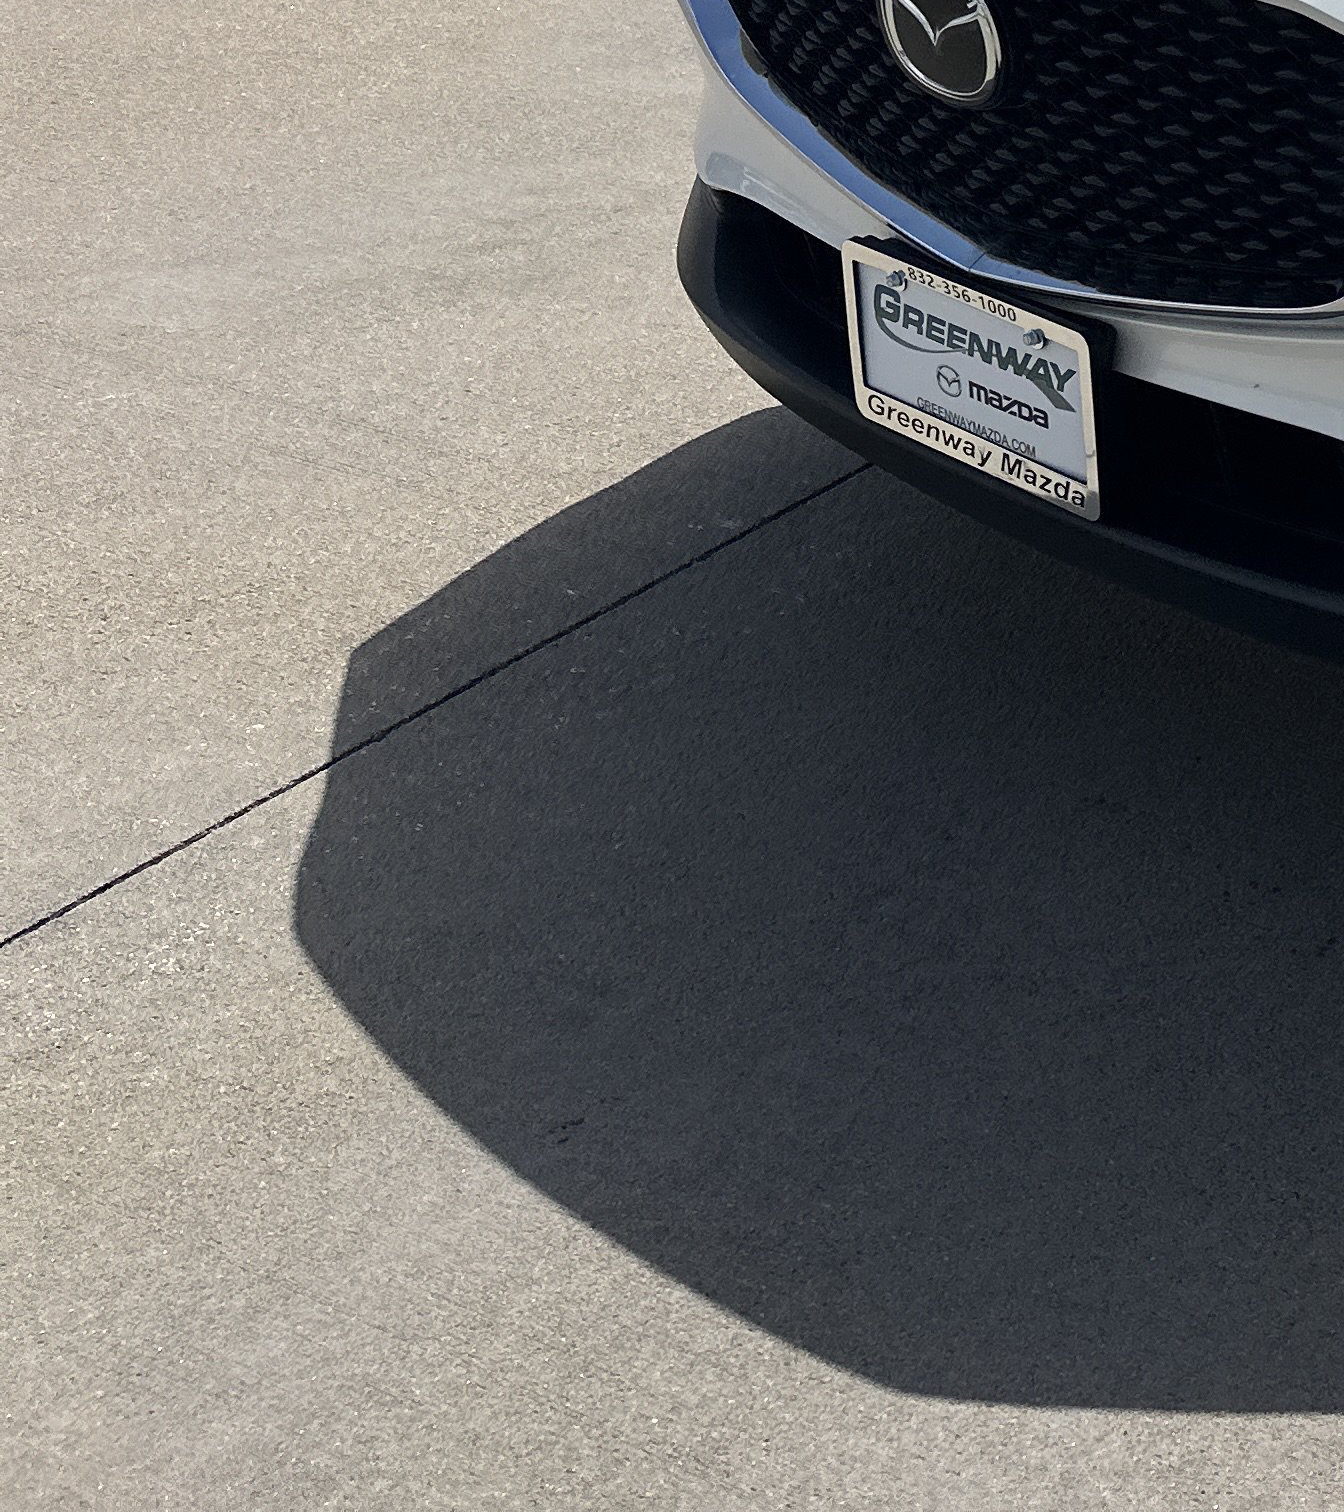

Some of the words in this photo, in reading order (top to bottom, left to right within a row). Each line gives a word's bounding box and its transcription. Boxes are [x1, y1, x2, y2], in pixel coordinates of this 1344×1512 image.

[907, 266, 1017, 322] 832-356-1000
[873, 284, 1077, 394] GREENWAY
[867, 394, 993, 468] Greenway
[1000, 452, 1086, 508] Mazda
[916, 396, 1037, 458] GREENWAYMAZDA.COM
